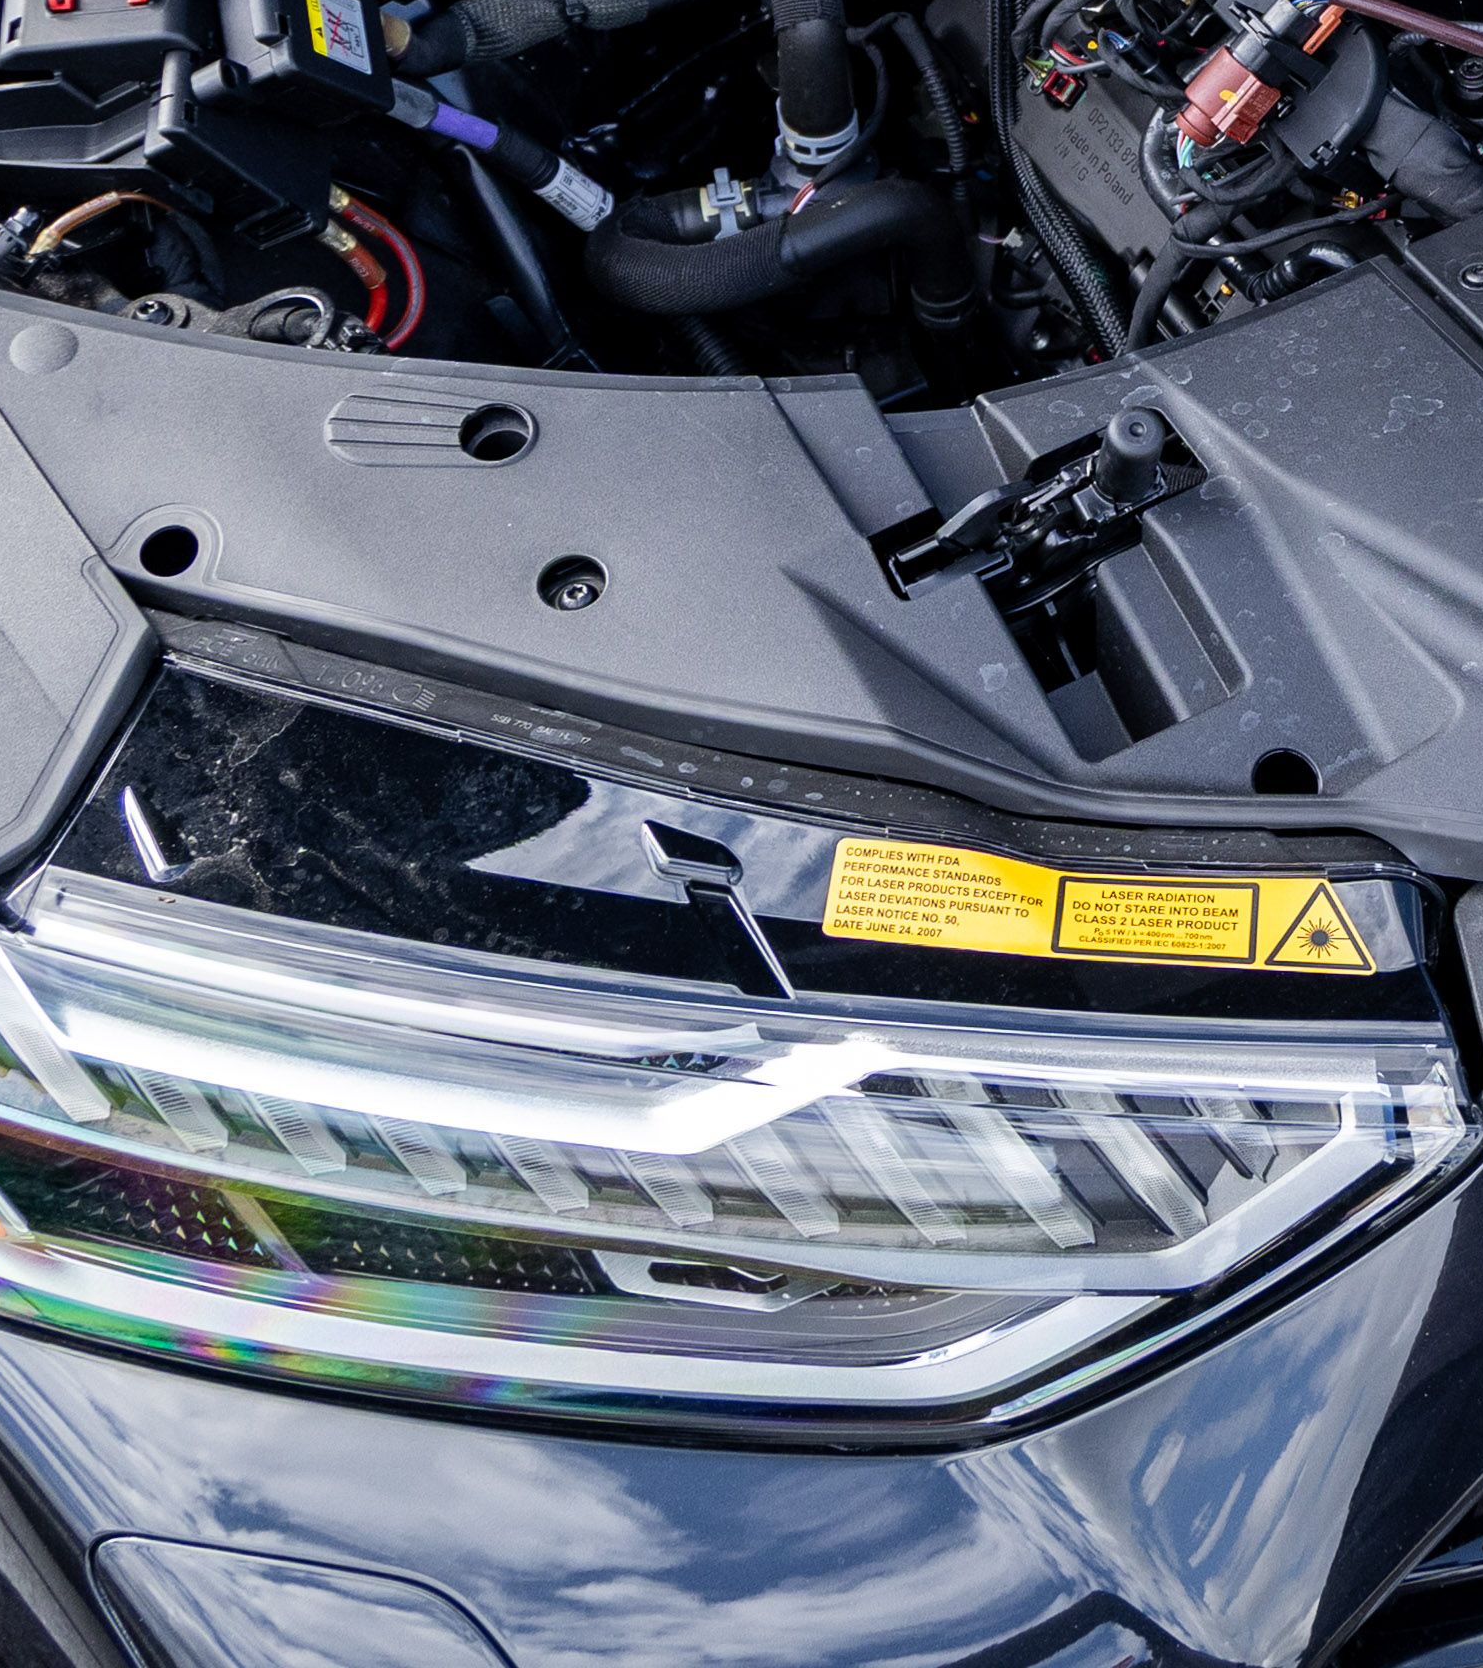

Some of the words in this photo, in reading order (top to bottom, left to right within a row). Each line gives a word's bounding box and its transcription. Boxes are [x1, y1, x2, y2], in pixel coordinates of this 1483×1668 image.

[1062, 119, 1090, 156] Made
[1088, 149, 1100, 167] in
[1098, 160, 1134, 205] Poland
[846, 847, 903, 861] COMPLIES
[907, 852, 934, 864] WITH
[937, 855, 960, 866] FDA
[843, 862, 929, 878] PERFORMANCE
[933, 869, 1001, 886] STANDARDS
[841, 876, 864, 886] FOR
[868, 878, 904, 890] LASER
[908, 882, 969, 896] PRODUCTS
[973, 889, 1017, 902] EXCEPT
[1020, 896, 1043, 907] FOR
[1102, 890, 1143, 901] LASER
[1147, 892, 1215, 904] RADIATION
[838, 890, 875, 902] LASER
[879, 894, 946, 909] DEVIATIONS
[949, 901, 1010, 915] PURSUANT
[1014, 907, 1029, 918] TO
[1072, 901, 1090, 911] DO
[1094, 903, 1120, 913] NOT
[1124, 904, 1165, 915] STARE
[1169, 906, 1199, 916] INTO
[1203, 908, 1239, 918] BEAM
[836, 905, 874, 916] LASER
[877, 909, 918, 921] NOTICE
[922, 914, 941, 924] NO.
[1074, 914, 1116, 925] CLASS
[1120, 916, 1127, 926] 2
[1131, 917, 1172, 928] LASER
[1177, 920, 1238, 931] PRODUCT
[834, 919, 863, 930] DATE
[866, 922, 895, 934] JUNE
[917, 927, 942, 938] 2007
[1079, 936, 1132, 945] CLASSIFIED
[1134, 938, 1152, 947] PER
[1154, 939, 1169, 947] IEC
